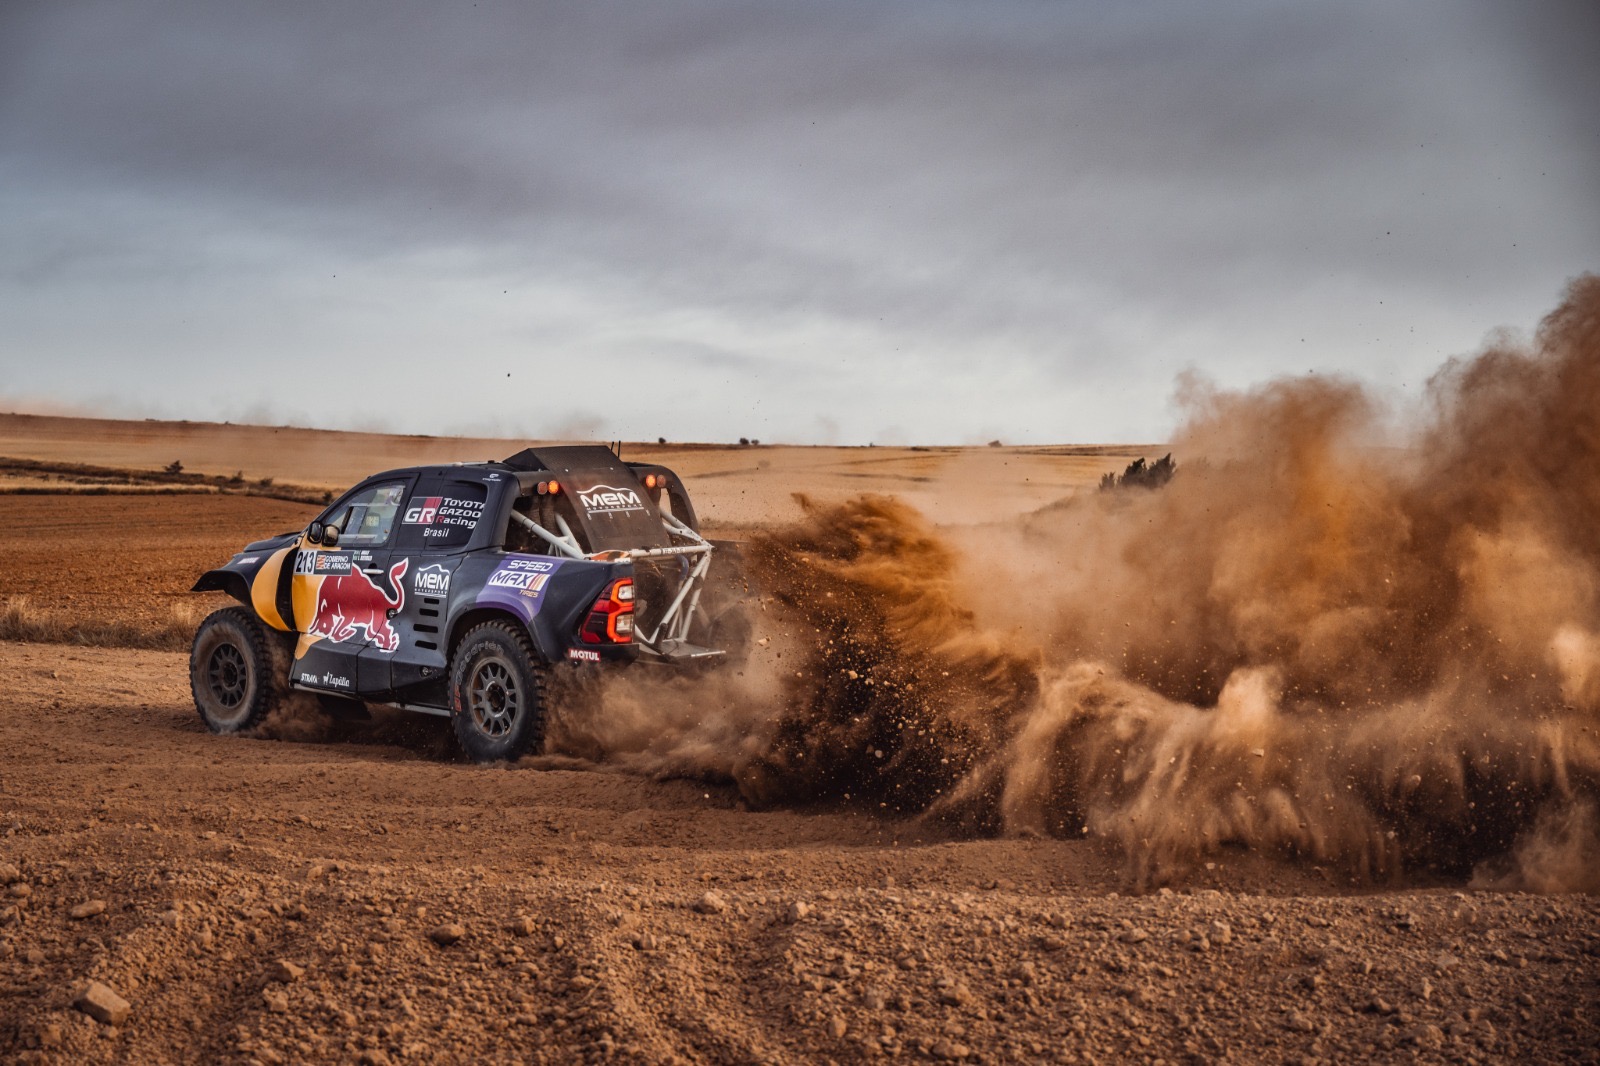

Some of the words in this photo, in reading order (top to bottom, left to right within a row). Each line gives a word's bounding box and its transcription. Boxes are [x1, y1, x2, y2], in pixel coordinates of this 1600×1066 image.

[404, 507, 436, 522] GR
[438, 506, 482, 518] GAZOO
[435, 515, 477, 529] Racing
[423, 527, 450, 537] Brasil
[295, 551, 315, 573] 213
[507, 559, 554, 572] SPEED
[491, 572, 535, 588] MAX
[519, 589, 540, 598] TIRES
[570, 649, 600, 661] MOTUL
